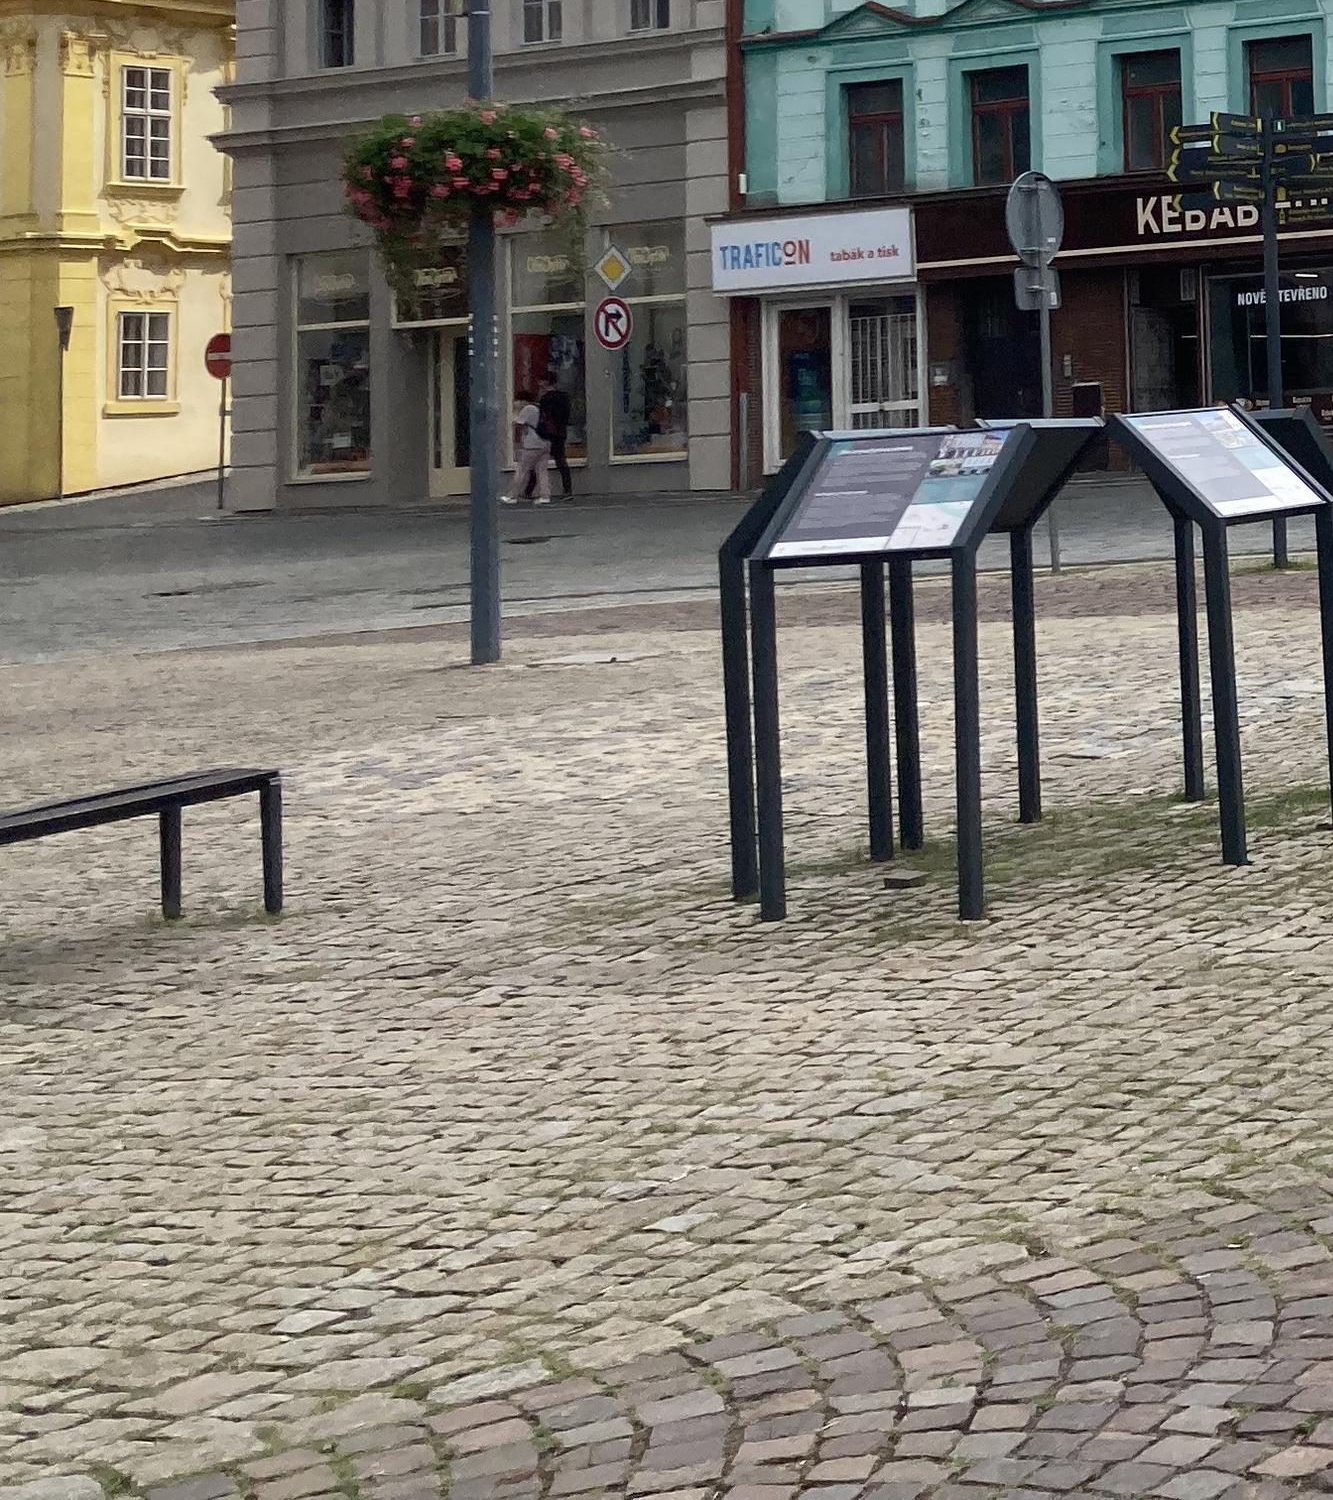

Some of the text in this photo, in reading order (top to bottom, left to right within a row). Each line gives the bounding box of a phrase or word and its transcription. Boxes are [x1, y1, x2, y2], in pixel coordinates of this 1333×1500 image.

[720, 239, 810, 270] TRAFICON
[867, 250, 875, 259] a
[877, 244, 900, 258] tisk
[1278, 285, 1328, 303] TEVŘENO
